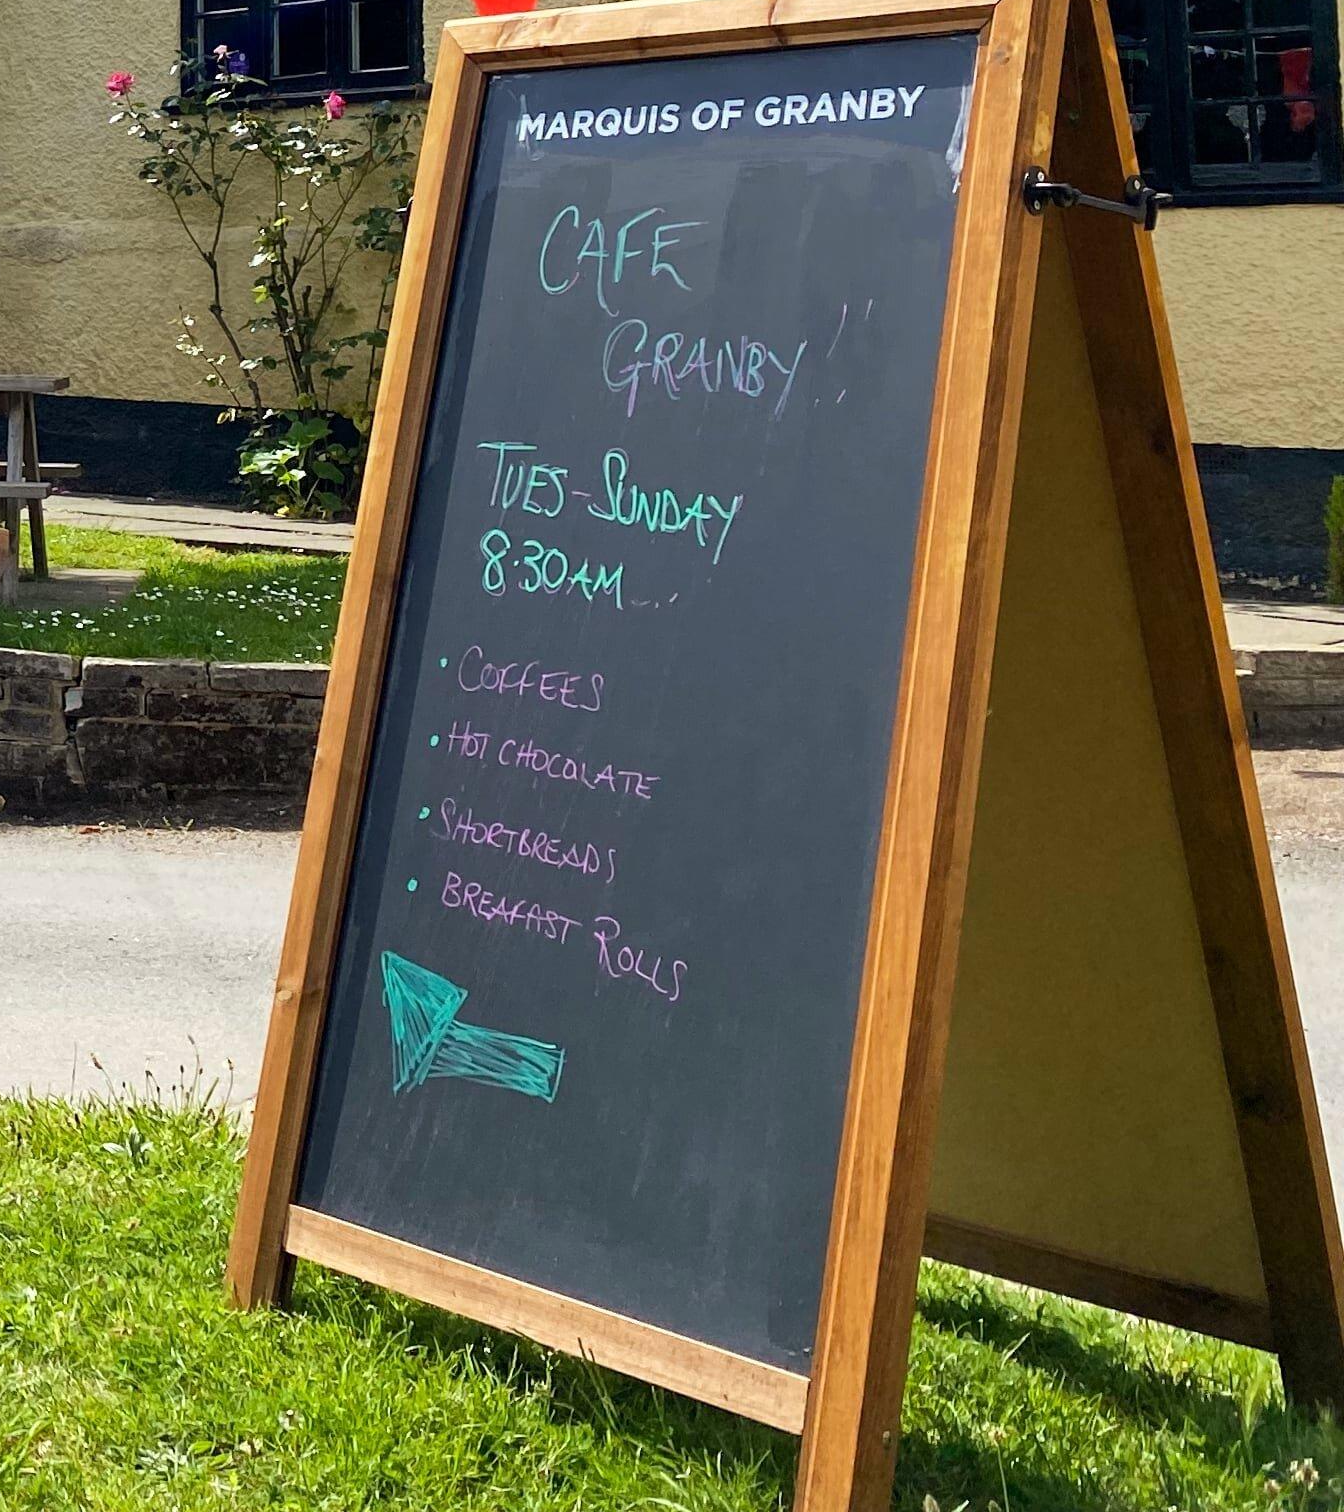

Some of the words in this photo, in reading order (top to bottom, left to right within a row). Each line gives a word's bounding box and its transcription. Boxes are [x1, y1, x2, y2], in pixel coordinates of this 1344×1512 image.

[518, 102, 680, 142] MARQUIS
[691, 98, 745, 132] OF
[754, 85, 926, 128] GRANBY
[539, 205, 710, 317] CAFE
[458, 645, 604, 712] COFFEES
[448, 720, 491, 760] HOT
[498, 738, 661, 800] CHOCOLATE
[432, 797, 617, 884] SHORTBREADS
[593, 916, 688, 1002] ROLLS
